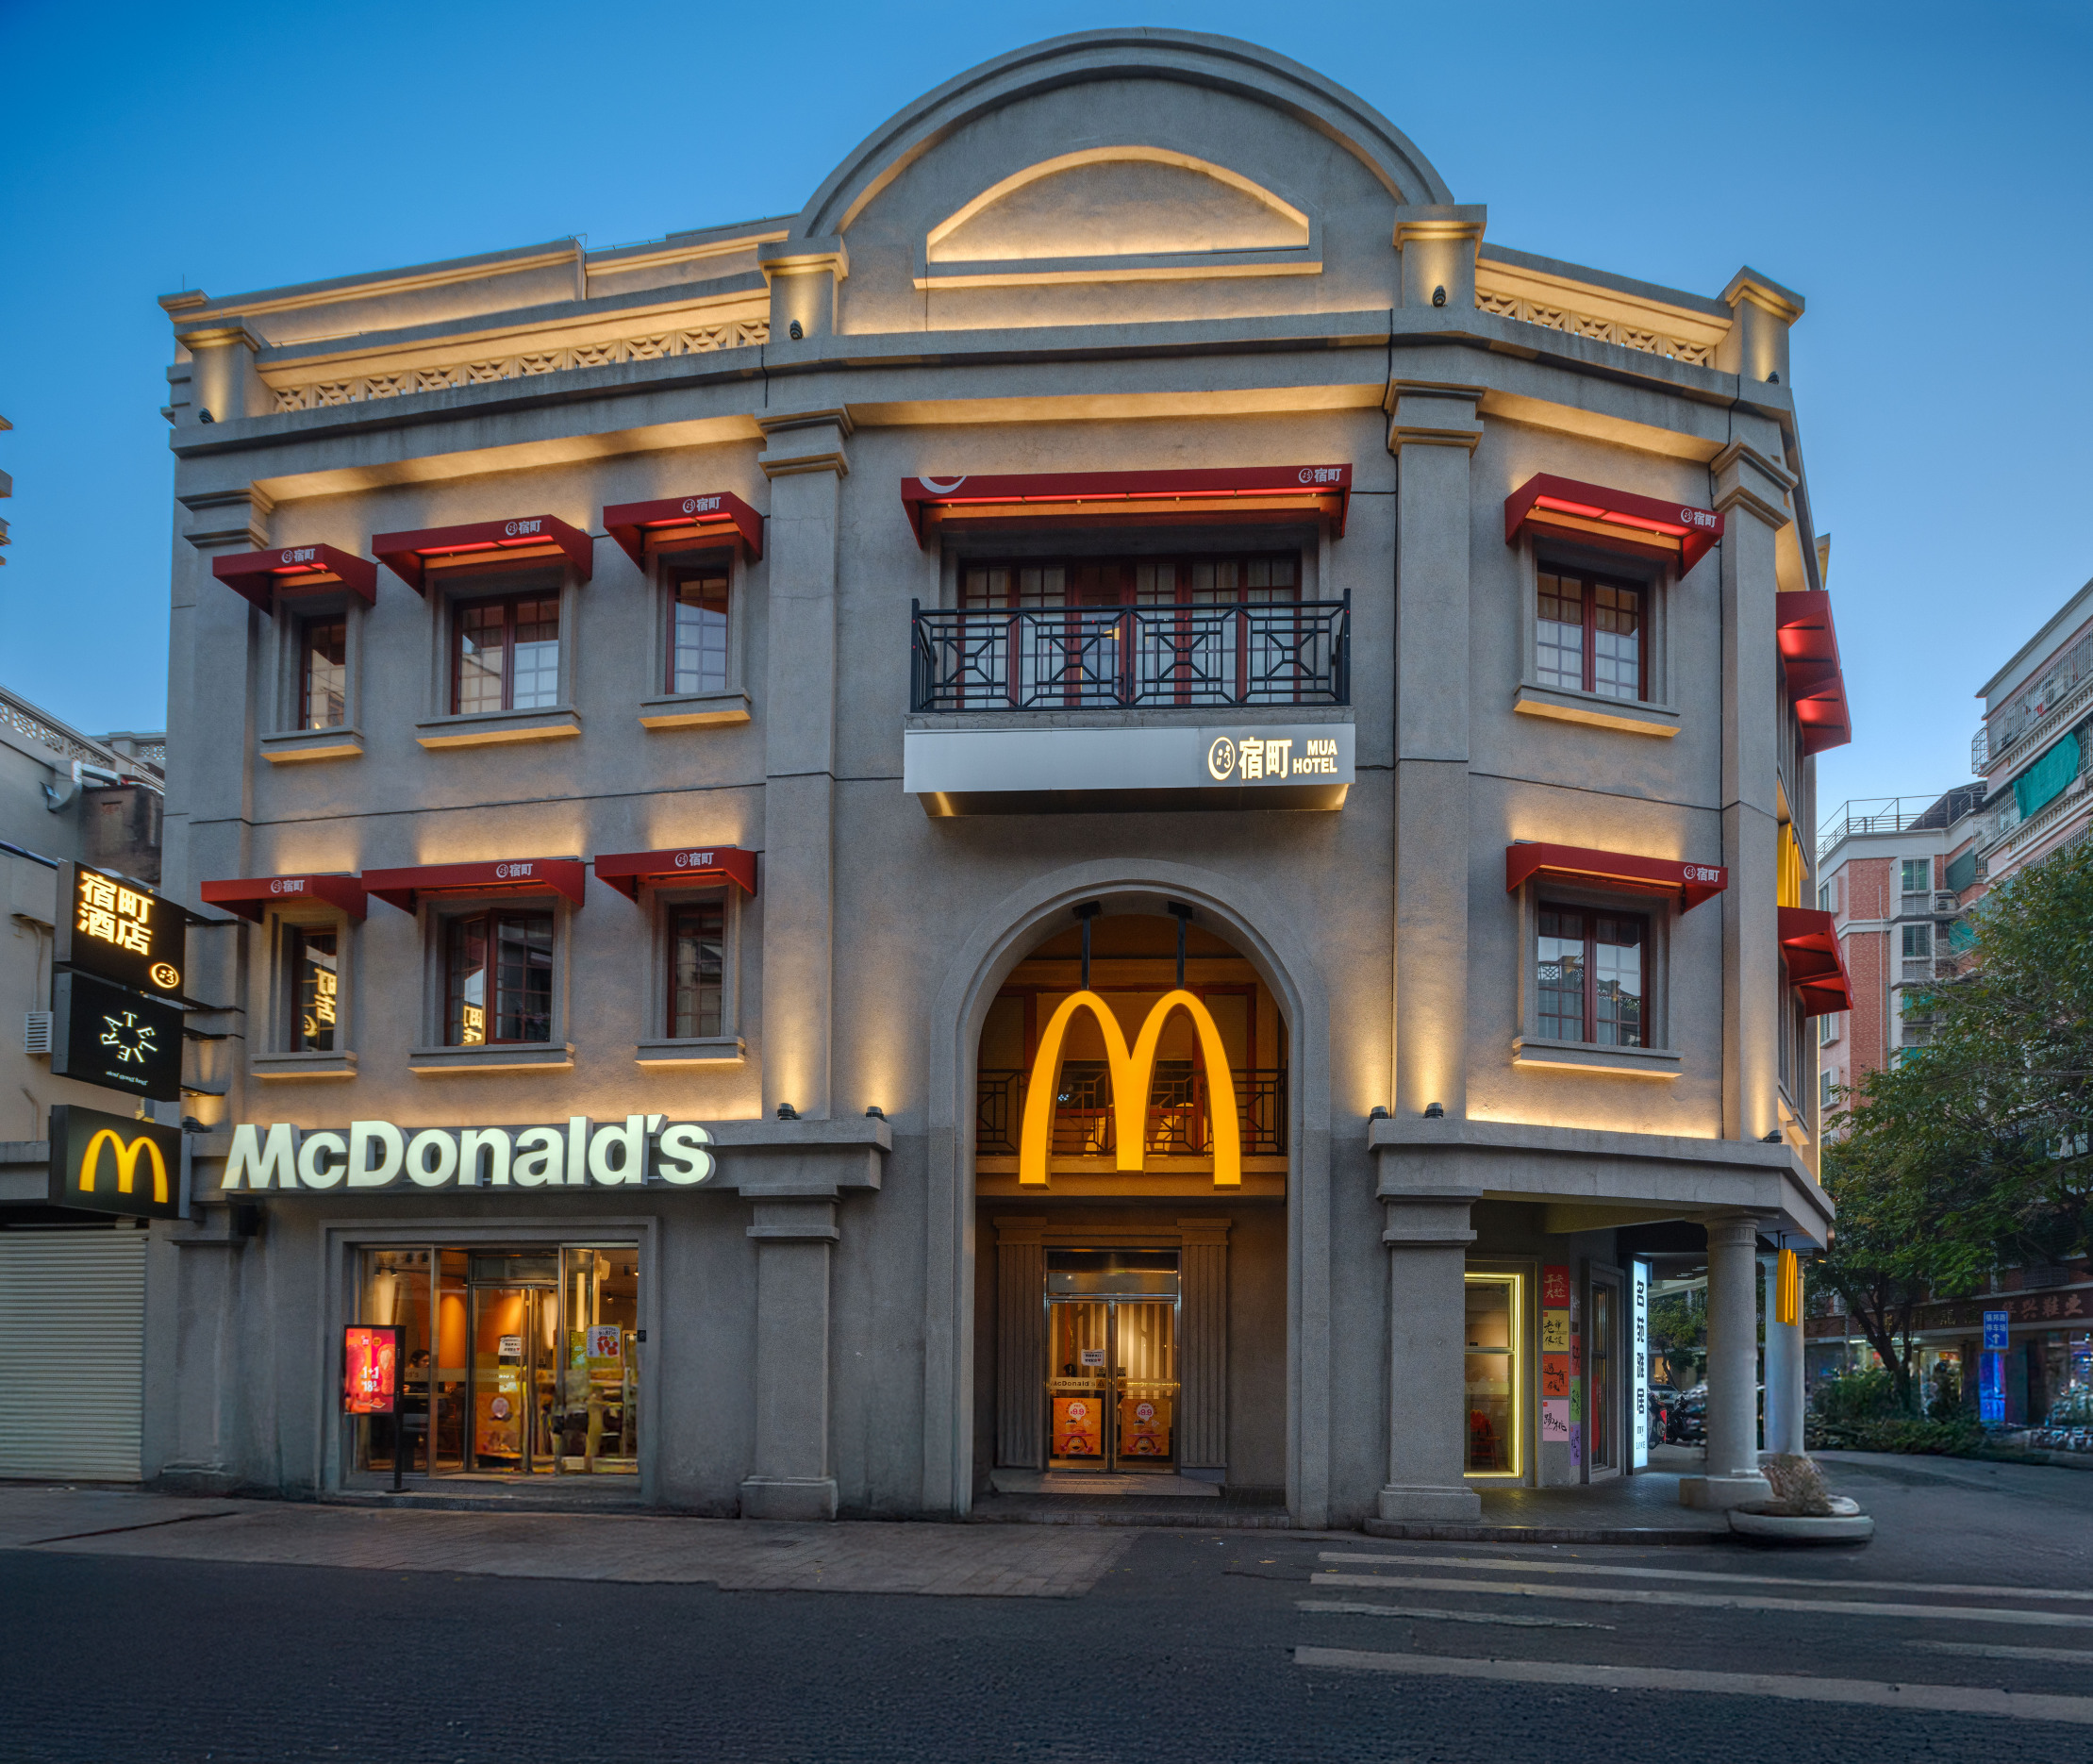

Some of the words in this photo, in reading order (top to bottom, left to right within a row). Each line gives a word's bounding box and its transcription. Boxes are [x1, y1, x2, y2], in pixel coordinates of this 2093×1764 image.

[1314, 467, 1342, 482] 宿町
[696, 496, 721, 511] 宿町
[1694, 510, 1717, 527] 宿町
[519, 520, 541, 534] 宿町
[293, 548, 315, 562] 宿町
[1307, 740, 1337, 756] MUA
[1238, 737, 1292, 779] 宿町
[1292, 757, 1337, 774] HOTEL
[689, 852, 714, 866] 宿町
[509, 863, 533, 877] 宿町
[1697, 867, 1719, 882] 宿町
[283, 879, 305, 892] 宿町
[78, 871, 155, 924] 宿町
[77, 902, 153, 956] 酒店
[221, 1114, 715, 1190] McDonald's
